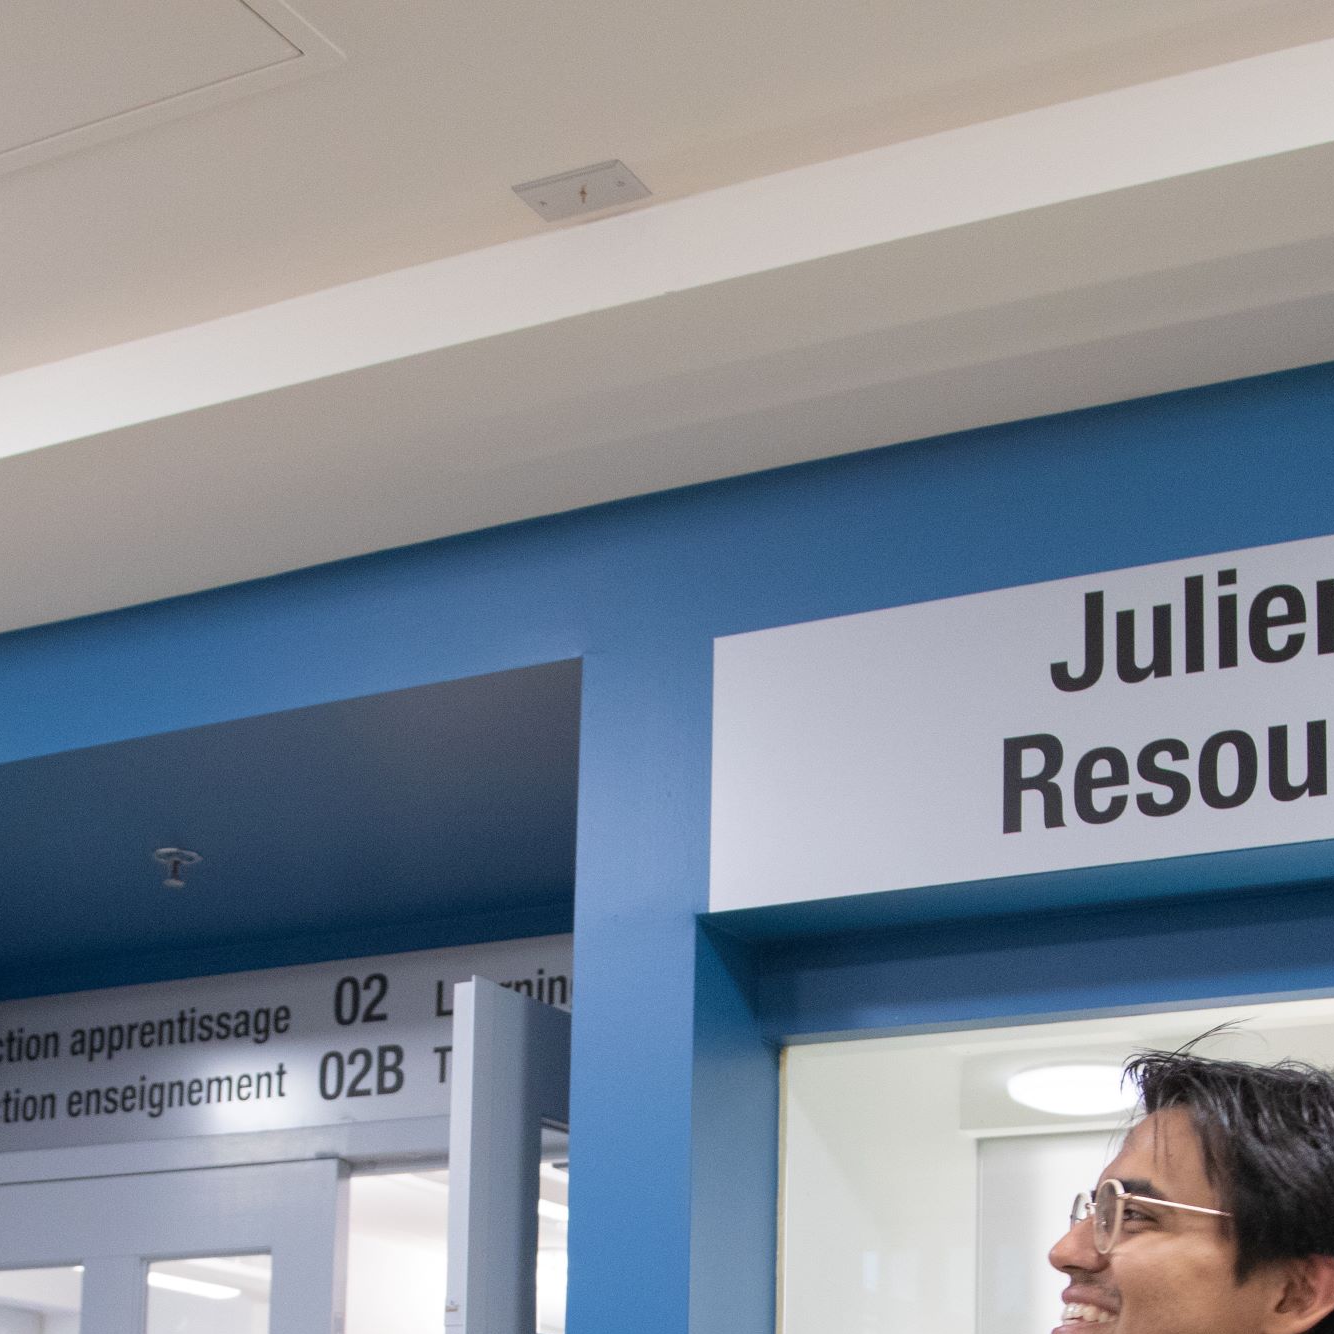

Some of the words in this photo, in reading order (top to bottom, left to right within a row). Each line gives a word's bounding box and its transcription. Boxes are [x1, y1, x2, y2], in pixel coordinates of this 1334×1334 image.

[70, 1004, 292, 1062] apprentissage
[334, 973, 389, 1026] 02
[68, 1062, 288, 1118] enseignement
[319, 1044, 405, 1100] 02B
